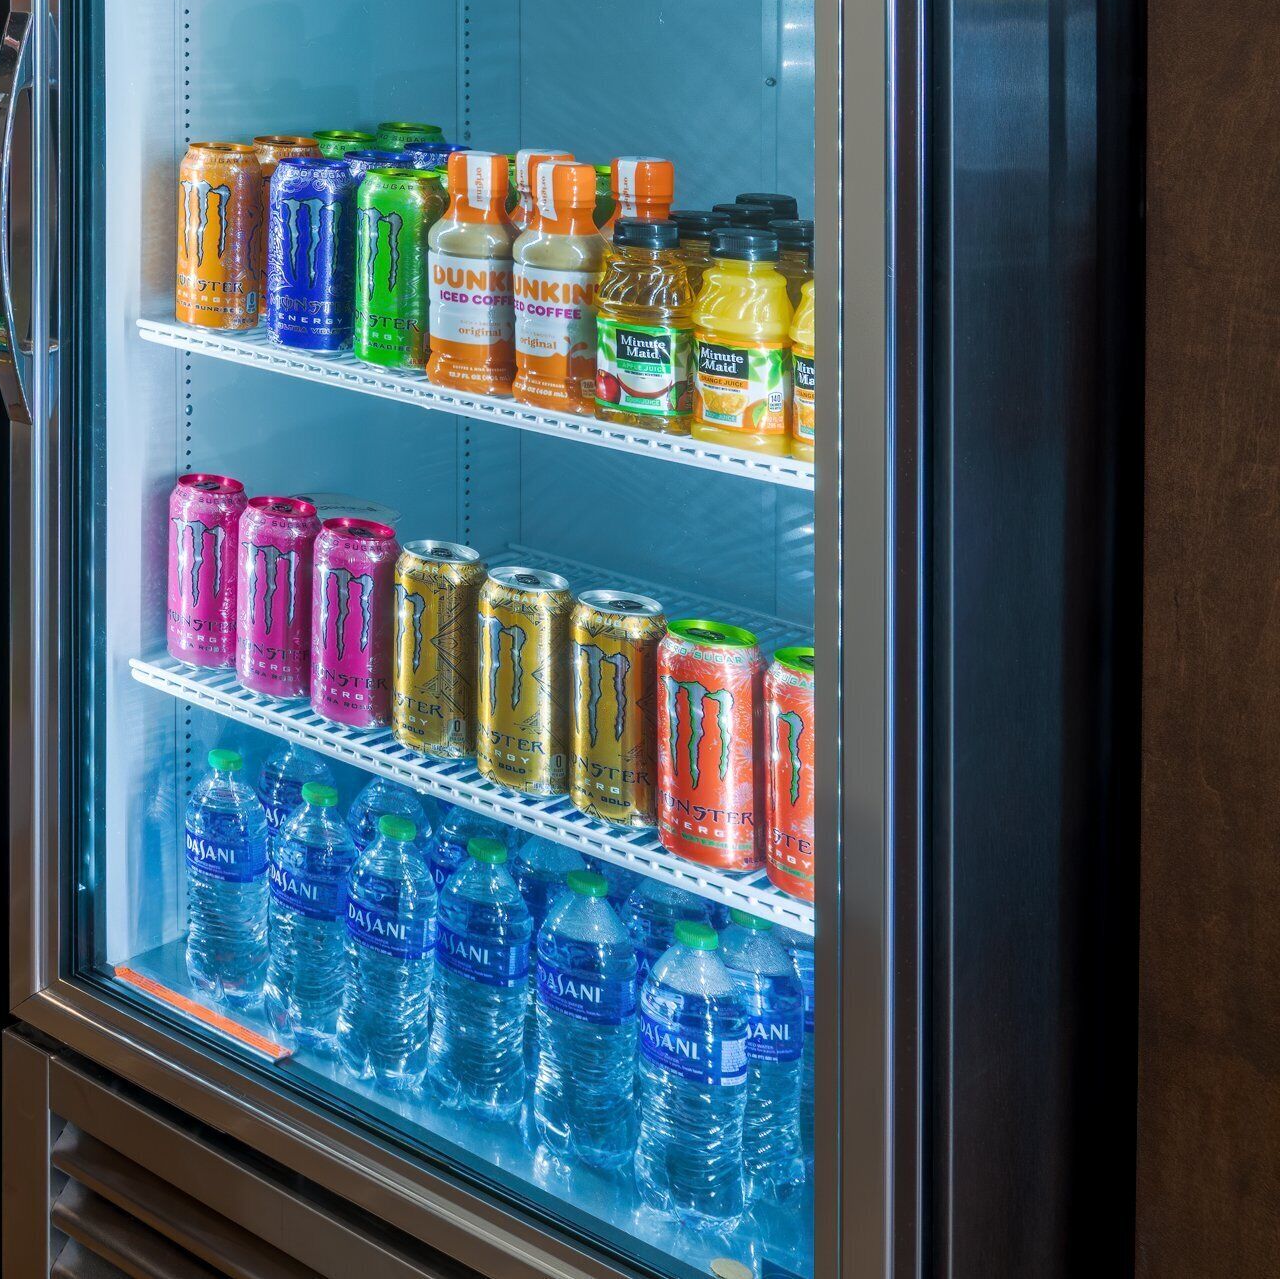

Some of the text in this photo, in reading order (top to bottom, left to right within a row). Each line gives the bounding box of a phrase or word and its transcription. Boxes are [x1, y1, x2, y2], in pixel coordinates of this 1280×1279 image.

[440, 291, 468, 305] ICED
[278, 312, 342, 325] ENERGY
[527, 303, 583, 320] COFFEE
[620, 333, 666, 350] Minute
[626, 345, 660, 360] Maid
[700, 347, 744, 364] Minute
[703, 358, 738, 374] Maid
[770, 394, 782, 403] 140
[198, 496, 236, 505] SUGAR
[343, 541, 384, 552] SUGAR
[169, 625, 229, 644] ENERGY
[240, 653, 303, 674] ENERGY
[692, 651, 743, 665] SUGAR
[313, 679, 376, 702] ENERGY
[498, 762, 527, 775] GOLD
[600, 795, 632, 808] GOLD
[662, 812, 742, 840] ENERGY
[186, 833, 237, 865] DASANI
[270, 865, 319, 901] DASANI
[348, 902, 407, 941] DASANI
[539, 965, 603, 1003] DASANI
[640, 1018, 701, 1061] DASANI
